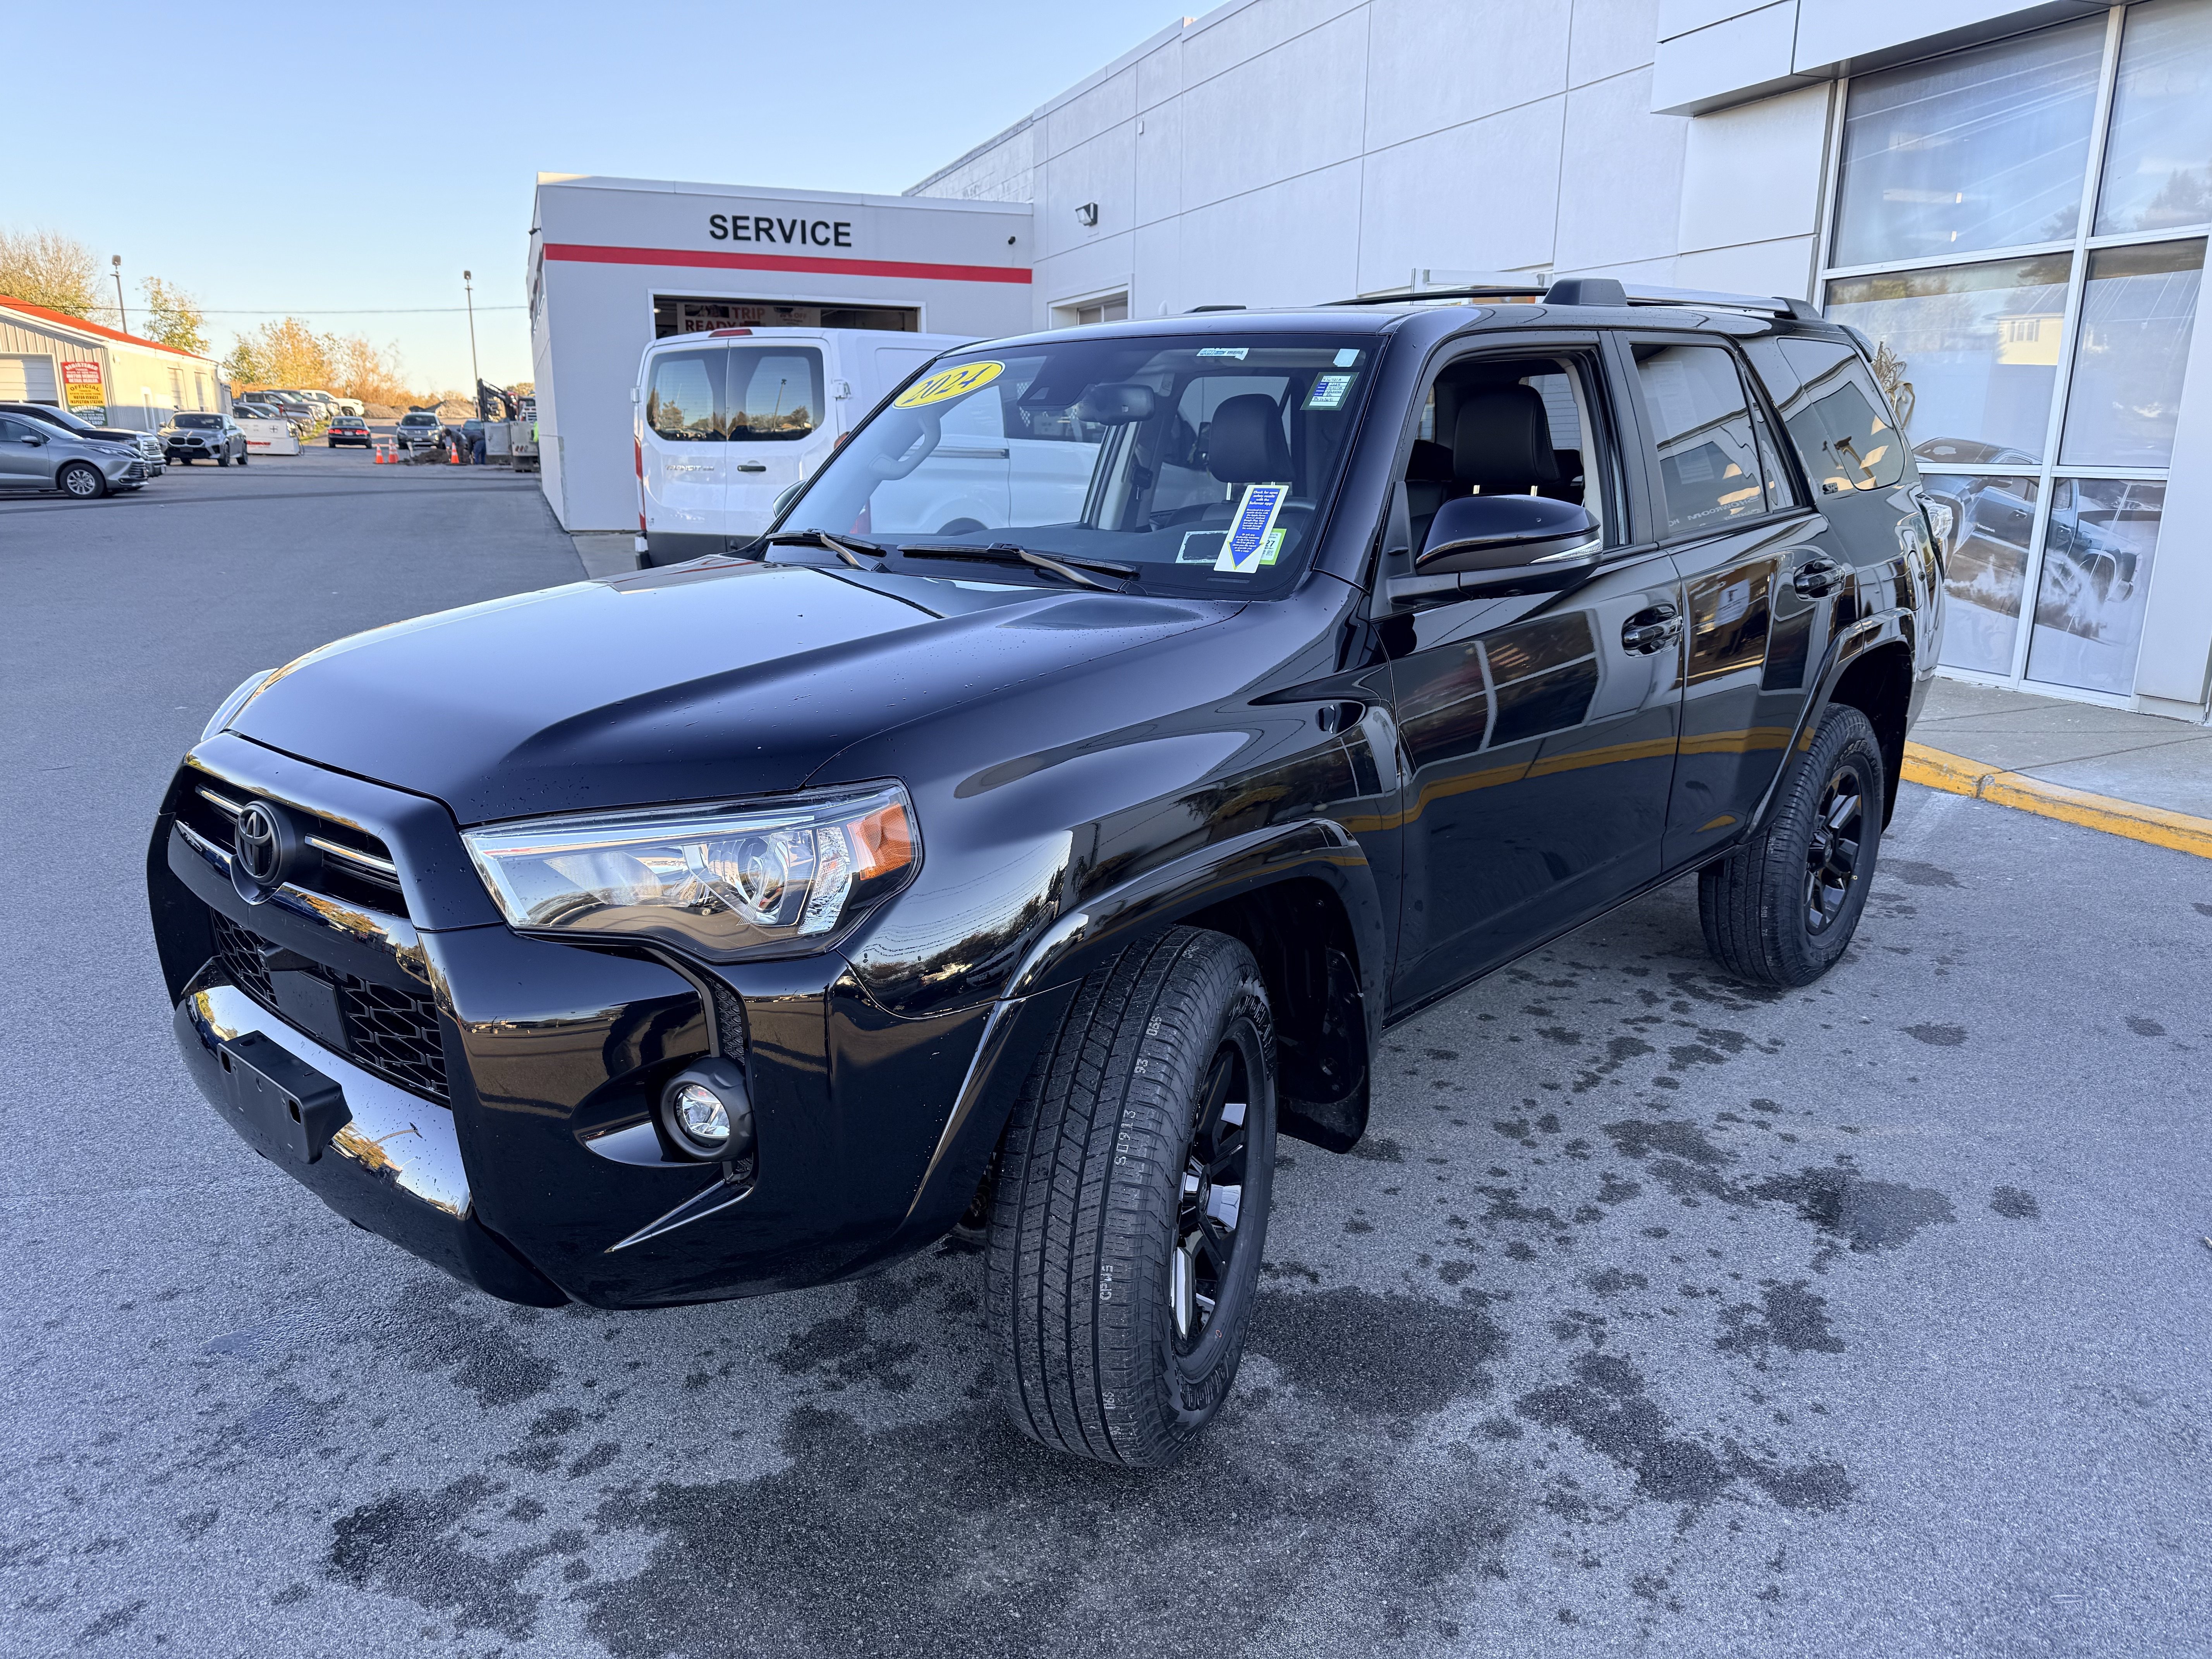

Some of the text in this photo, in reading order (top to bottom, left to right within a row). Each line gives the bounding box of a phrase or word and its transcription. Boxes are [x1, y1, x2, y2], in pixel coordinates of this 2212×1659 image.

[709, 214, 852, 247] SERVICE
[732, 307, 766, 319] TRIP
[901, 365, 993, 405] 2024
